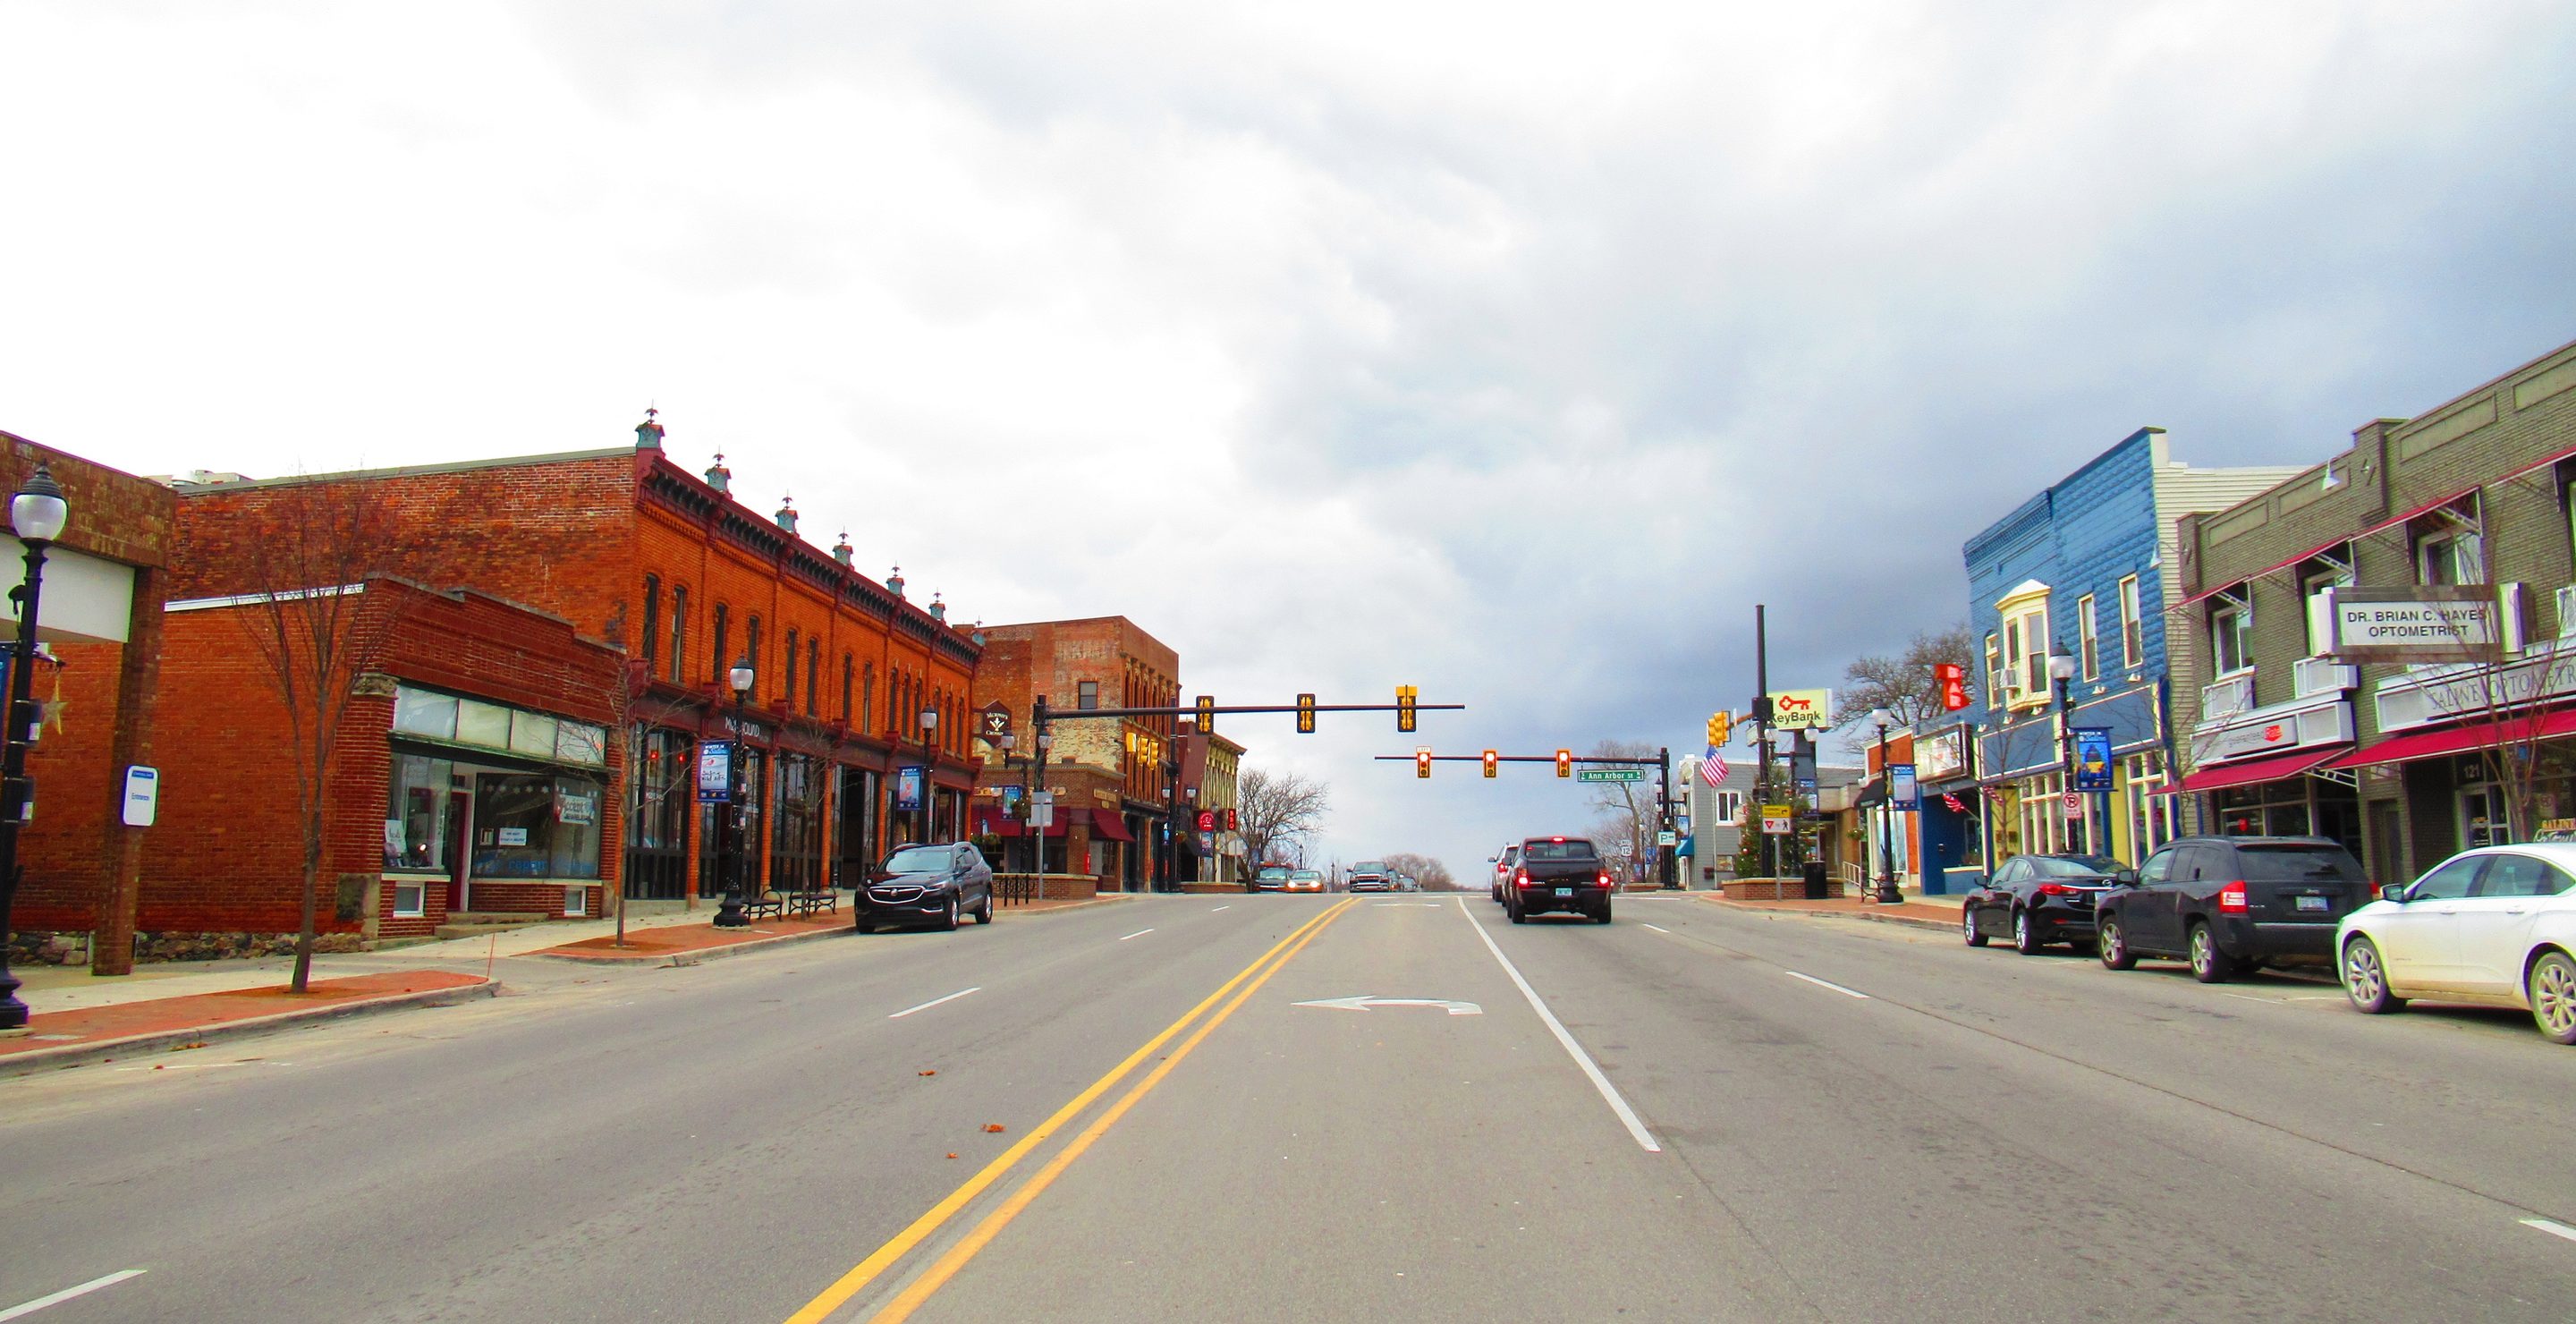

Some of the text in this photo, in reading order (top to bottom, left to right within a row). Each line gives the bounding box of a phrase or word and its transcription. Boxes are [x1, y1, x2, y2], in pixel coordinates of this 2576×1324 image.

[2348, 609, 2487, 622] DR. BRIAN C. HAYES
[2368, 625, 2469, 637] OPTOMETRIST
[1947, 666, 1961, 707] BAR
[2432, 683, 2479, 709] SALINE
[1772, 711, 1821, 725] KeyBank
